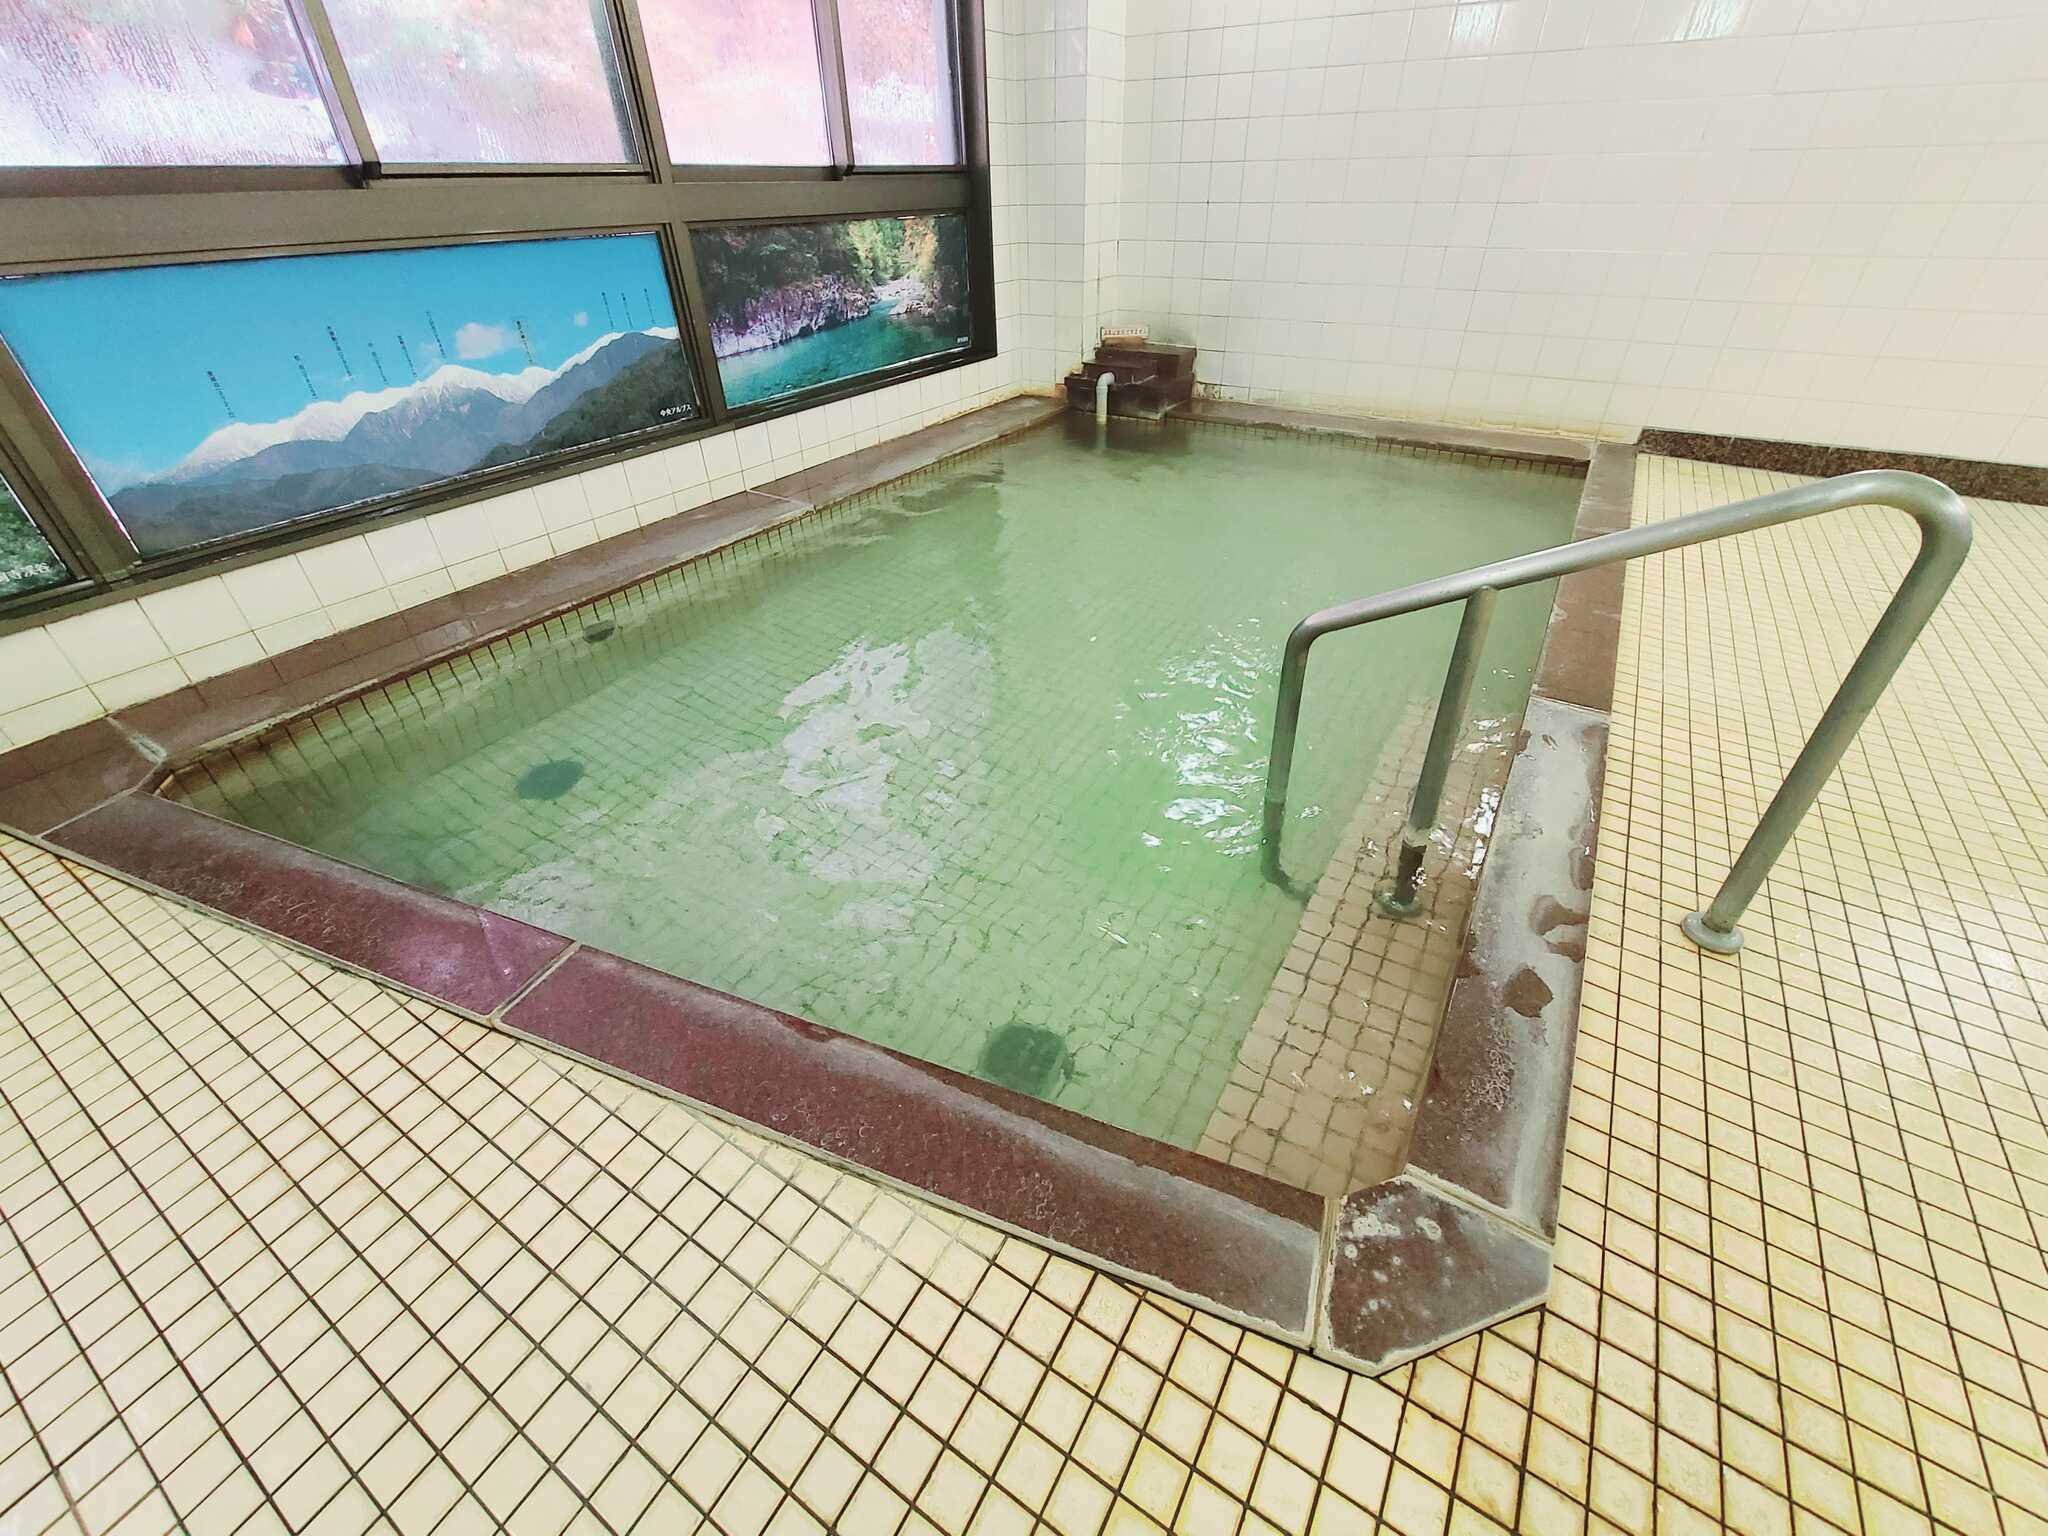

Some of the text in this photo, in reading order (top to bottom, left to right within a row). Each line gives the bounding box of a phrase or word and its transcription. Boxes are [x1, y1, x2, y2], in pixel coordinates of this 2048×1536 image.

[660, 403, 692, 417] 中央アルプス
